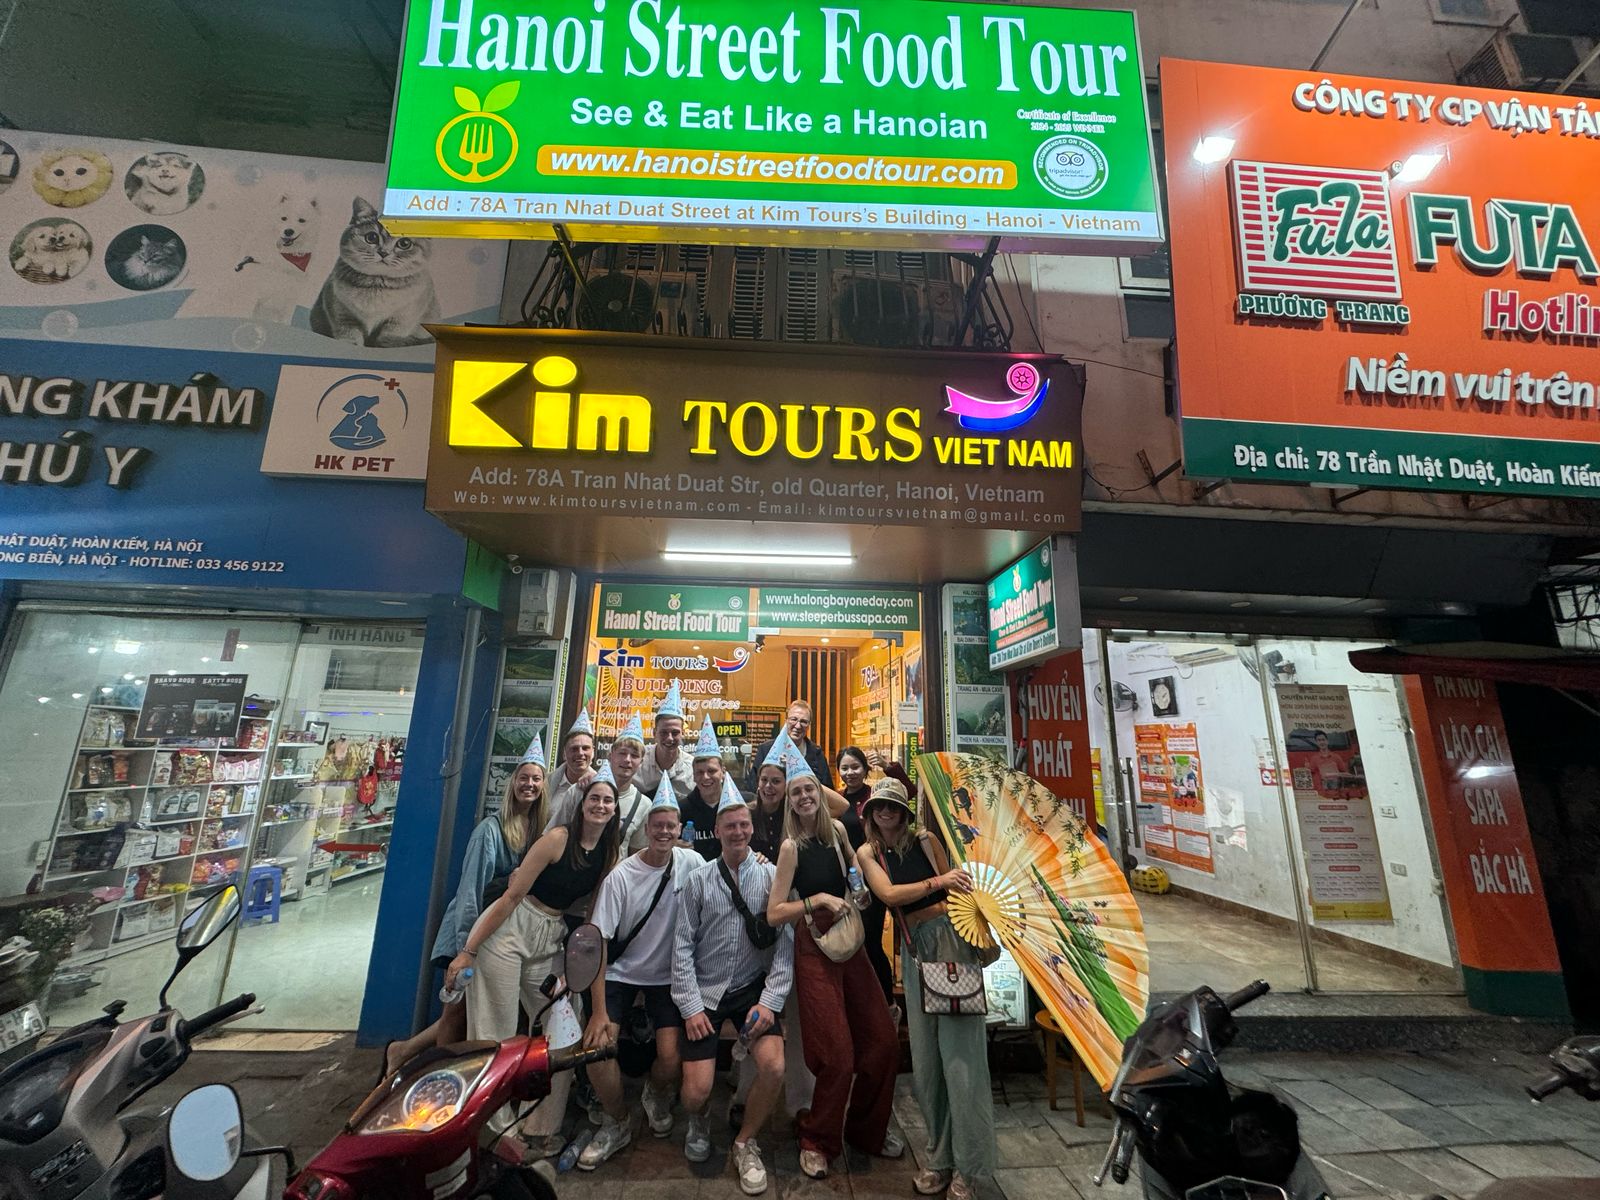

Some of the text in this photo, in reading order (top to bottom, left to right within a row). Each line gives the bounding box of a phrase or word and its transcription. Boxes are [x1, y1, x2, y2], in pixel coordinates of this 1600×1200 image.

[419, 0, 1127, 97] Hanoi Street Food Tour
[570, 97, 988, 139] See & Eat Like a Hanoian
[1017, 108, 1116, 123] Certificate of Excellence
[1292, 80, 1386, 118] CÔNG
[1390, 92, 1436, 122] TY
[1438, 97, 1482, 125] CP
[1484, 97, 1552, 134] VẬN
[551, 149, 1004, 185] www.hanoistreetfoodtour.com
[407, 195, 449, 212] Add
[470, 197, 508, 214] 78A
[514, 198, 557, 215] Tran
[565, 200, 611, 216] Nhat
[618, 201, 665, 217] Duat
[671, 202, 730, 219] Street
[737, 205, 754, 220] at
[762, 204, 800, 222] Kim
[807, 206, 877, 224] Tours's
[885, 208, 967, 229] Building
[987, 211, 1043, 229] Hanoi
[1061, 214, 1141, 232] Vietnam
[1406, 192, 1600, 280] FUTA
[1239, 293, 1410, 325] PHƯƠNG TRANG
[1348, 352, 1595, 408] Niềm vui trên
[89, 373, 255, 425] KHÁM
[449, 356, 1073, 469] Kim TOURS VIET NAM
[105, 447, 140, 485] Y
[315, 454, 395, 473] HK PET
[1234, 444, 1268, 473] Địa
[1275, 447, 1310, 470] chỉ:
[1317, 450, 1341, 472] 78
[1346, 450, 1392, 475] Trần
[1398, 454, 1444, 483] Nhật
[1450, 457, 1502, 487] Duật,
[1506, 462, 1554, 485] Hoàn
[469, 467, 1045, 504] Add: 78A Tran Nhat Duat Str, old Quarter, Hanoi, Vietnam
[454, 490, 496, 505] Web:
[503, 493, 740, 514] www.kimtoursvietnam.com
[759, 502, 812, 516] Email:
[819, 504, 1066, 524] kimtoursvietnam@gmail.com
[29, 533, 68, 549] DUẬT,
[71, 536, 111, 549] HOÀN
[112, 536, 150, 552] KIẾM,
[154, 538, 172, 551] HÀ
[176, 539, 203, 554] NỘI
[68, 551, 87, 565] HÀ
[91, 552, 118, 569] NỘI
[130, 556, 193, 569] HOTLINE:
[196, 559, 221, 570] 033
[224, 560, 249, 571] 456
[251, 561, 285, 572] 9122
[766, 593, 914, 609] www.halongbayoneday.com
[772, 611, 908, 626] www.sleeperbussapa.com
[604, 609, 742, 633] Hanoi Street Food Tour
[598, 648, 708, 670] Kim TOURS
[701, 696, 740, 710] offices
[1028, 670, 1082, 721] HUYỂN
[717, 724, 742, 736] OPEN
[1033, 731, 1072, 778] PHÁT
[1464, 787, 1509, 826] SAPA
[1470, 838, 1534, 895] BẮC HÀ
